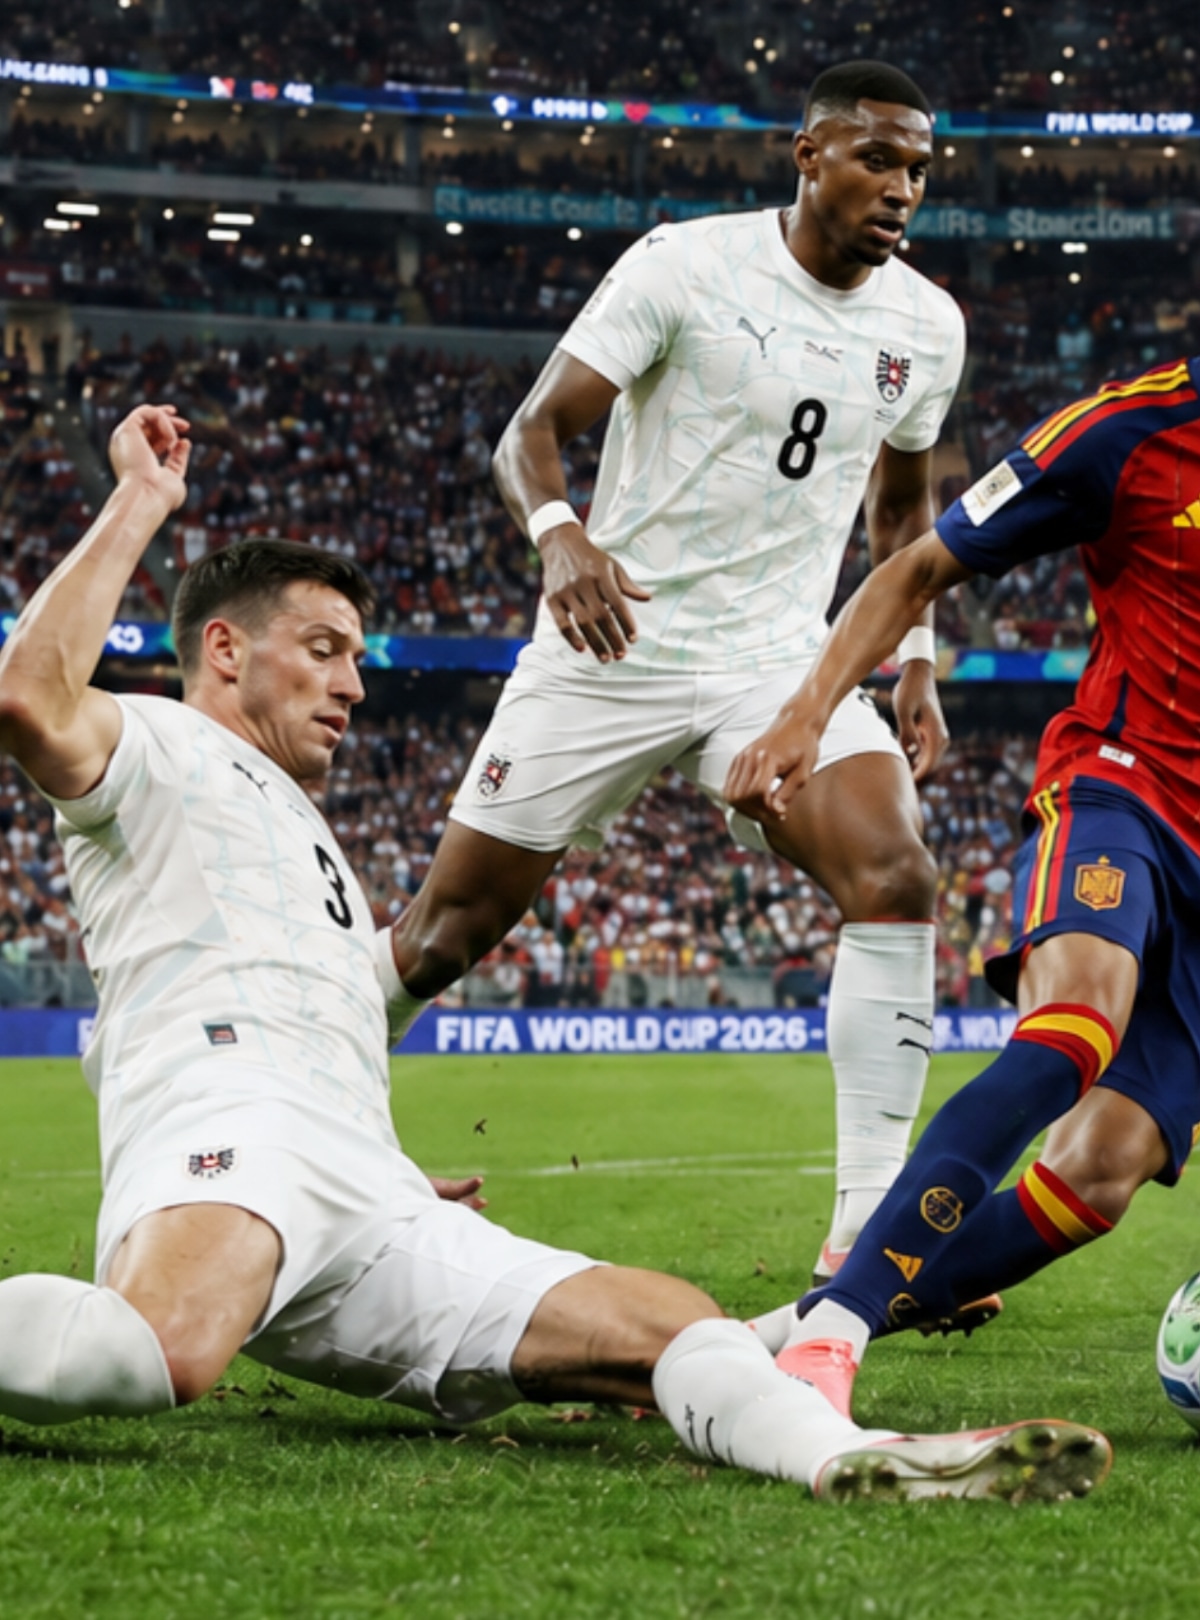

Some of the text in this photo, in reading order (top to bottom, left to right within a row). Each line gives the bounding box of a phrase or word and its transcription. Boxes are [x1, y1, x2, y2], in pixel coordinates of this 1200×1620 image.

[1047, 112, 1088, 132] FIFA
[1091, 112, 1155, 132] WORLD
[1156, 112, 1193, 132] CUP
[777, 398, 827, 481] 8
[314, 843, 354, 930] 3
[437, 1016, 520, 1051] FIFA
[528, 1016, 662, 1050] WORLD
[664, 1016, 717, 1050] CUP
[719, 1016, 808, 1050] 2026
